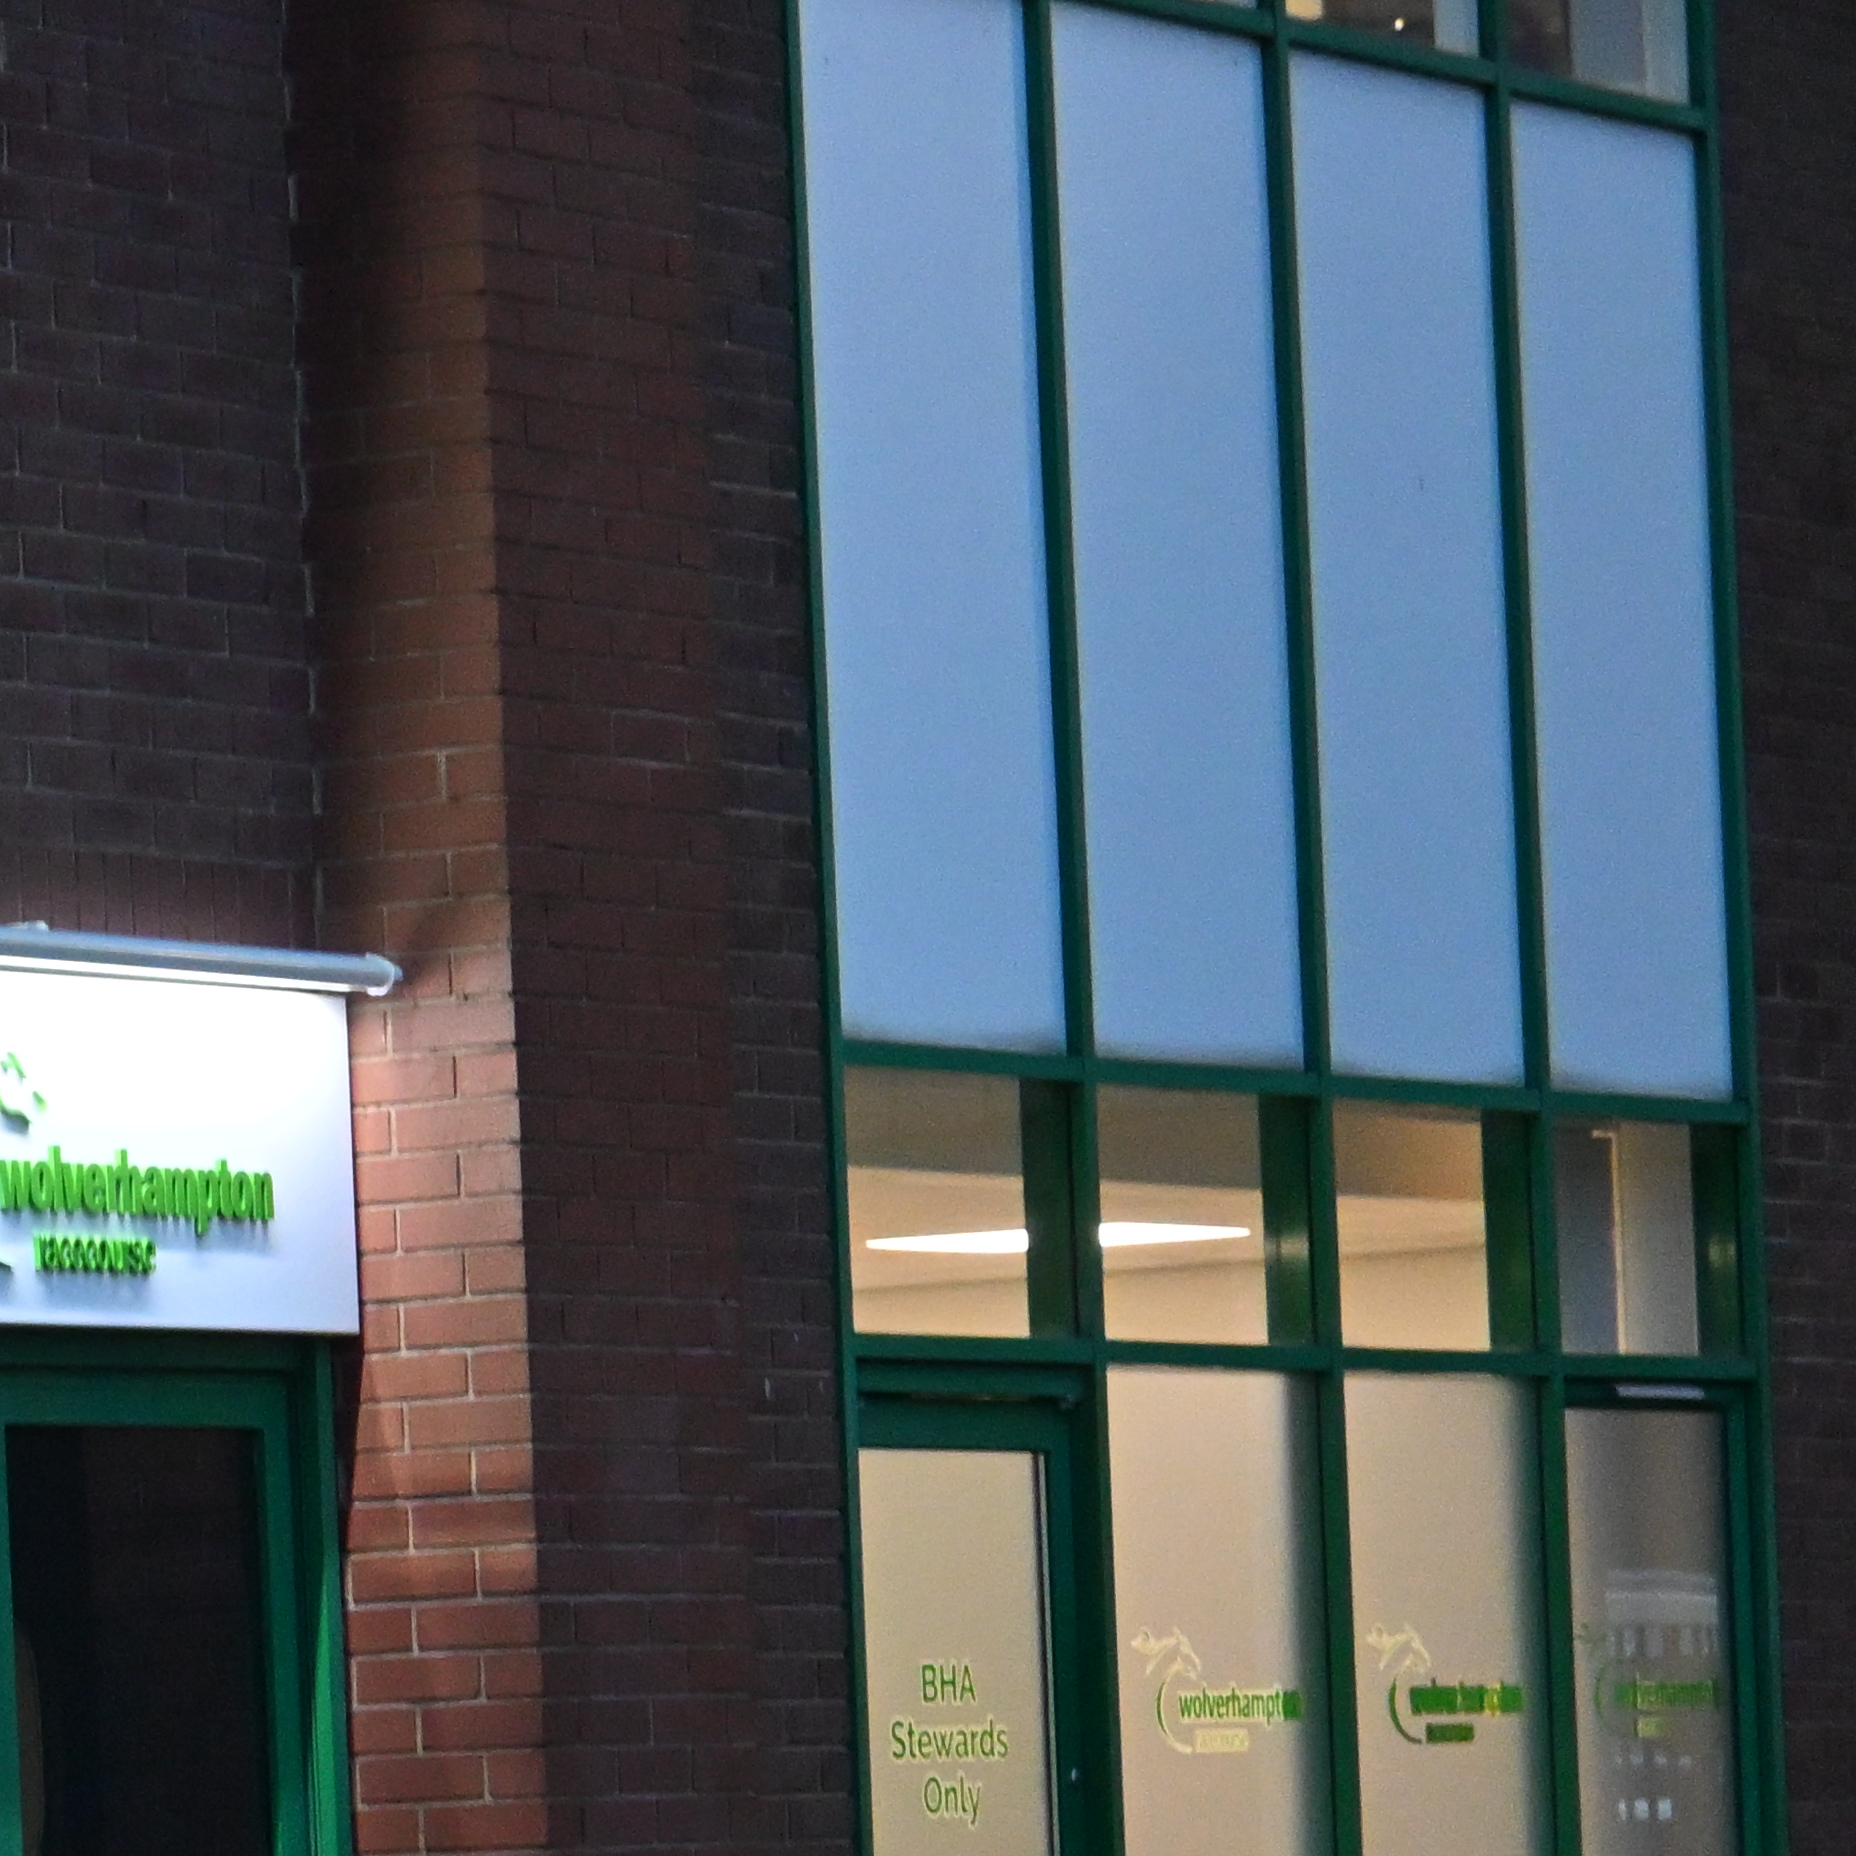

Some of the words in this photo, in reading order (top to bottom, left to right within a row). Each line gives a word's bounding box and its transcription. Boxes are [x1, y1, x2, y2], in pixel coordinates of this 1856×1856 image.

[32, 1232, 157, 1275] racecourse
[921, 1662, 977, 1705] BHA
[1178, 1683, 1303, 1727] wolverhampt
[891, 1716, 1009, 1761] Stewards
[922, 1774, 982, 1827] Only
